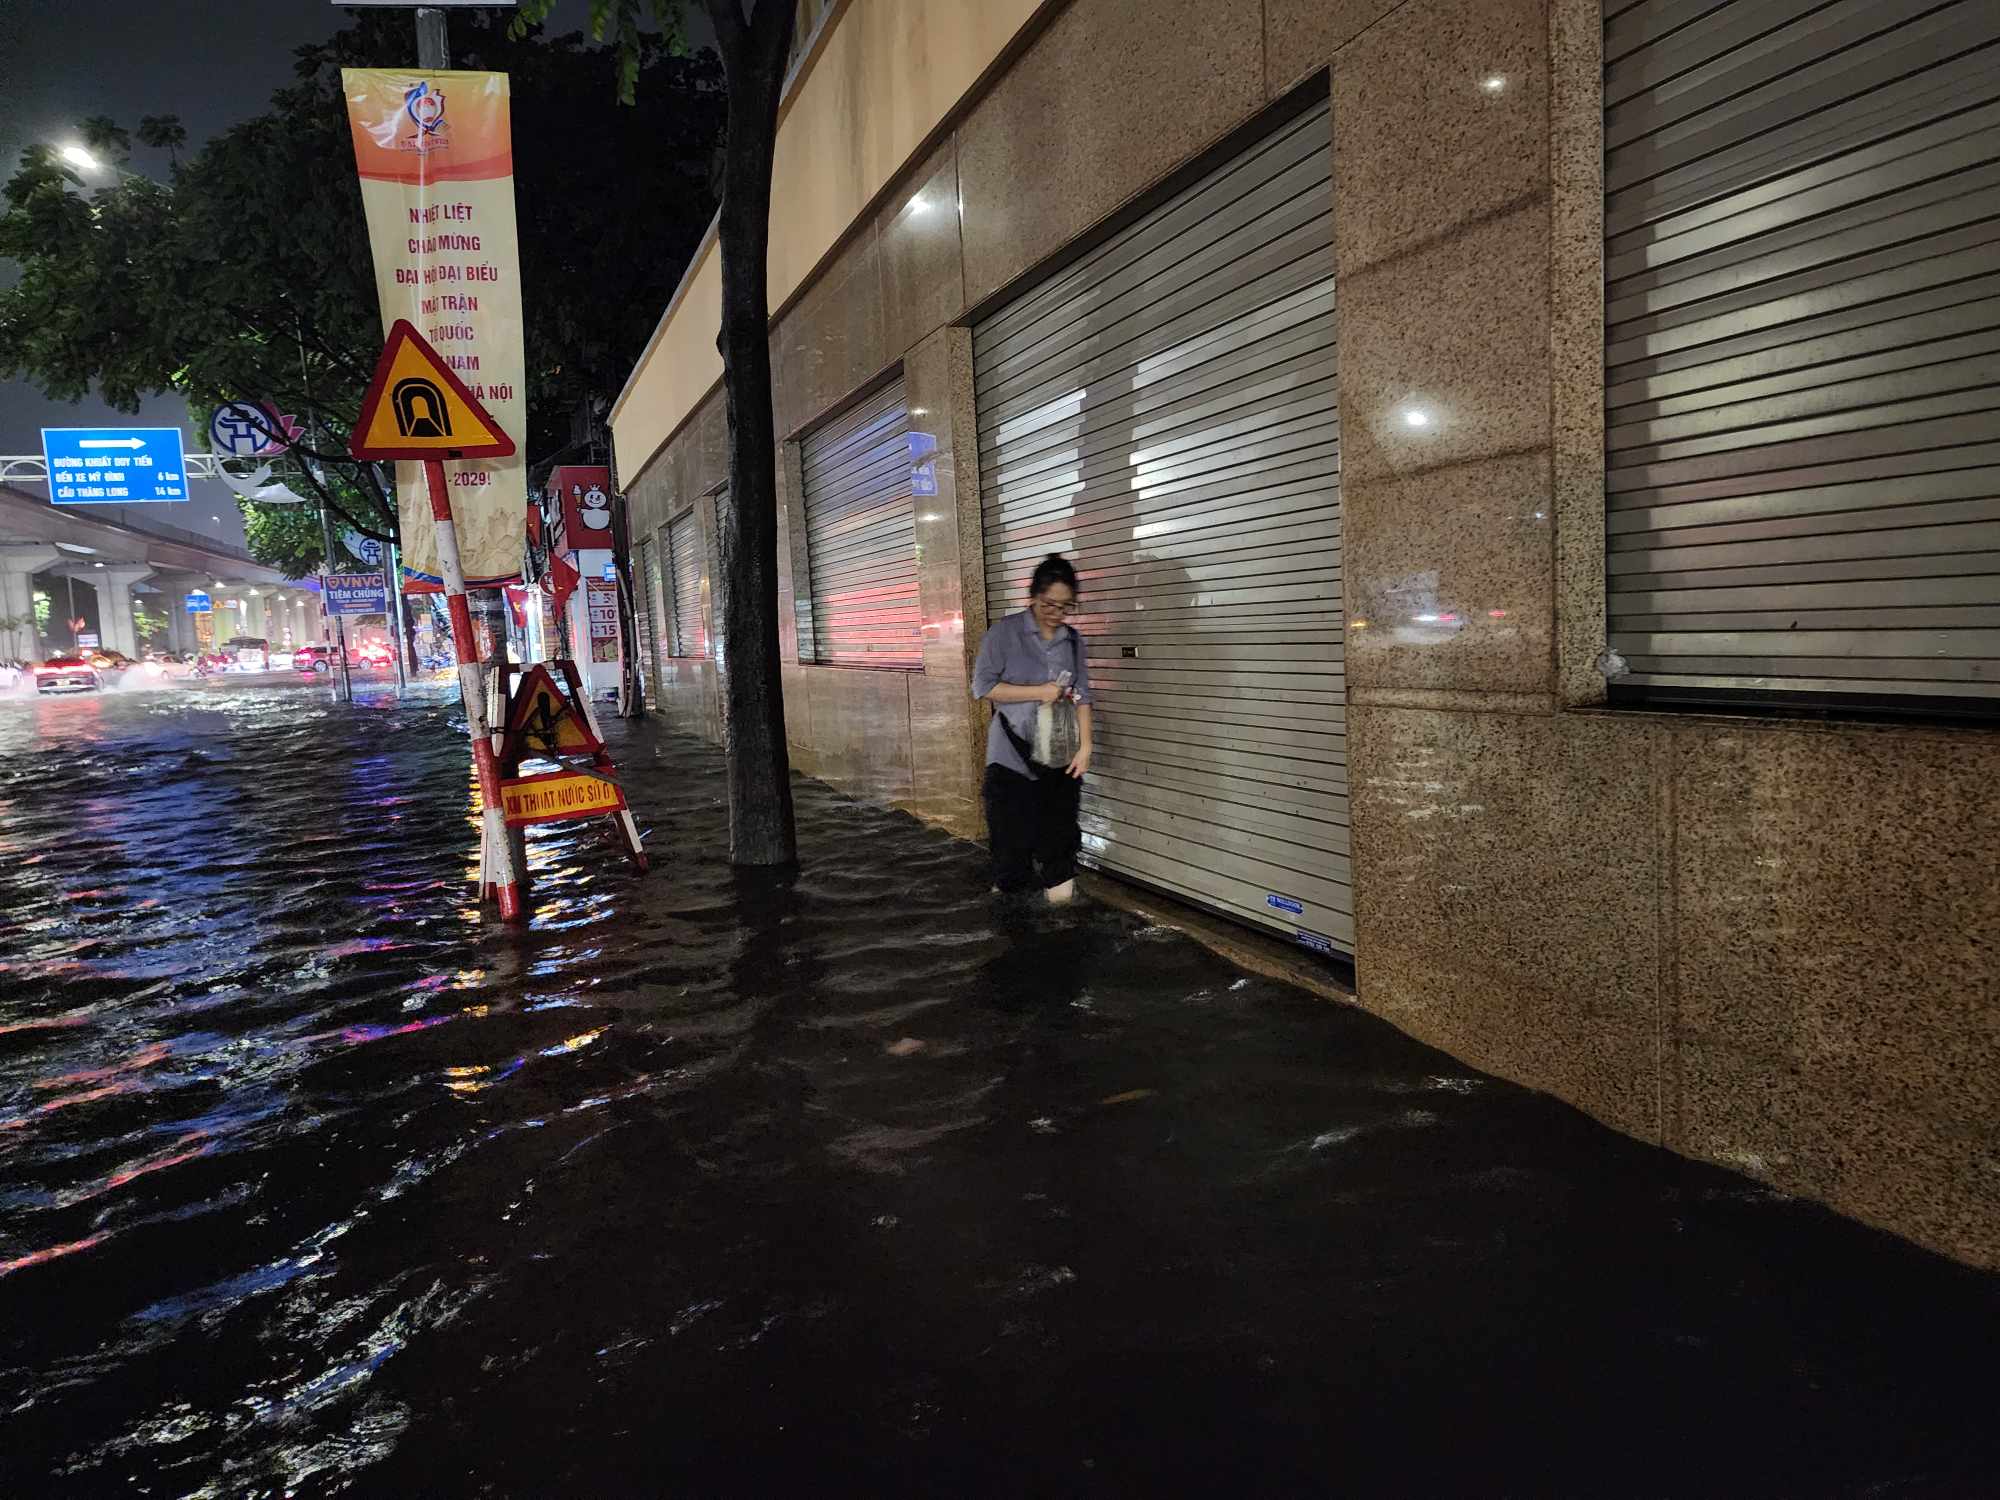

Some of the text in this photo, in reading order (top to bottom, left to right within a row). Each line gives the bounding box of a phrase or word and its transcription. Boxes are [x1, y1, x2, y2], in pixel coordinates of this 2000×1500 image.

[444, 202, 473, 223] LIỆT
[438, 232, 480, 251] MỪNG
[395, 268, 419, 287] ĐẠI
[439, 265, 461, 283] ĐẠI
[466, 260, 498, 281] BIỂU
[440, 292, 478, 314] TRẬN
[440, 320, 474, 342] QUỐC
[446, 355, 480, 371] NAM
[489, 382, 512, 403] NỘI
[106, 487, 129, 497] LONG
[341, 576, 382, 587] VNVC
[328, 588, 352, 599] TIÊM
